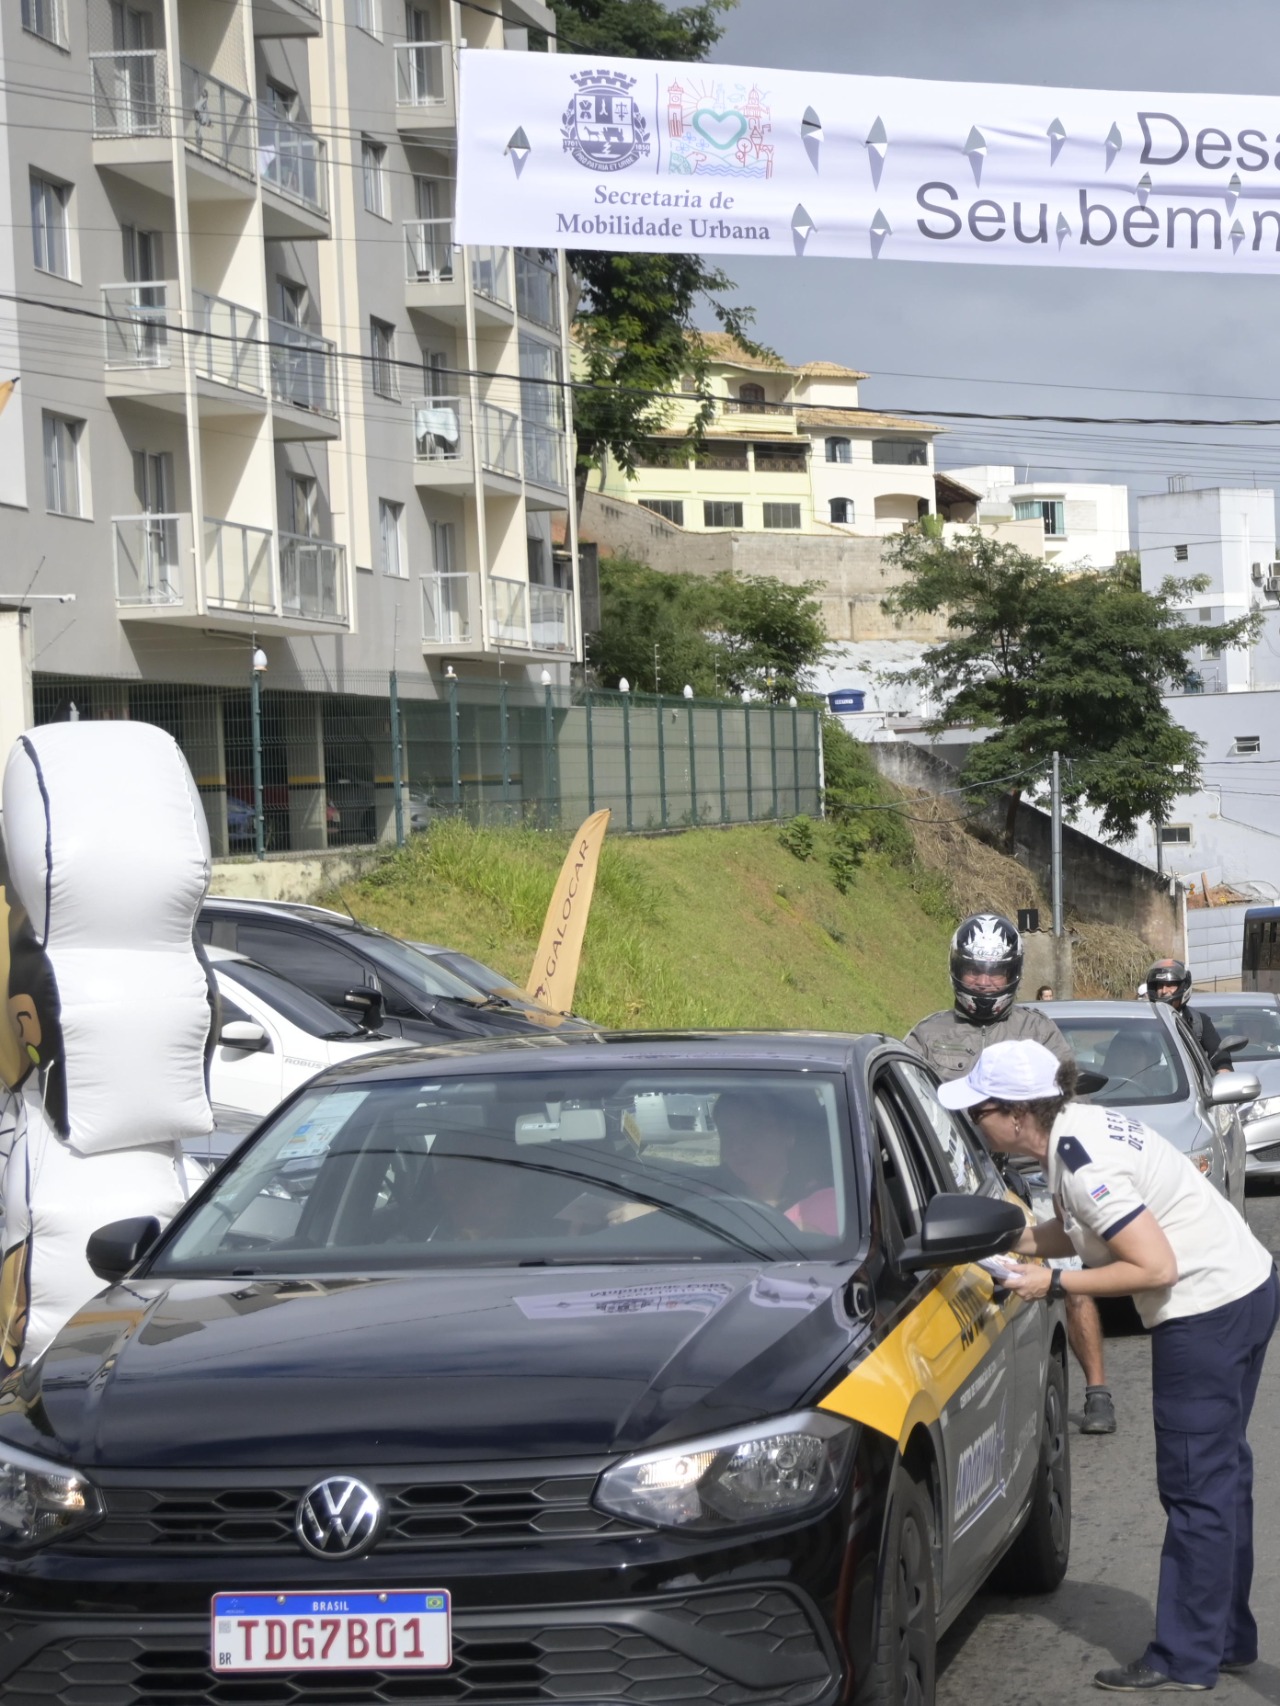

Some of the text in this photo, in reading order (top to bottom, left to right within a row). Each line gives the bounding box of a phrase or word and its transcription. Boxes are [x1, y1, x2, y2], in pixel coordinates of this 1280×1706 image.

[594, 184, 735, 210] Secretaria de
[556, 212, 771, 240] Mobilidade Urbana
[914, 181, 1049, 244] Seu
[1078, 189, 1223, 249] bem
[545, 838, 590, 978] GALOCAR
[312, 1601, 350, 1612] BRASIL
[237, 1617, 425, 1661] TDG7B01
[219, 1652, 232, 1665] BR
